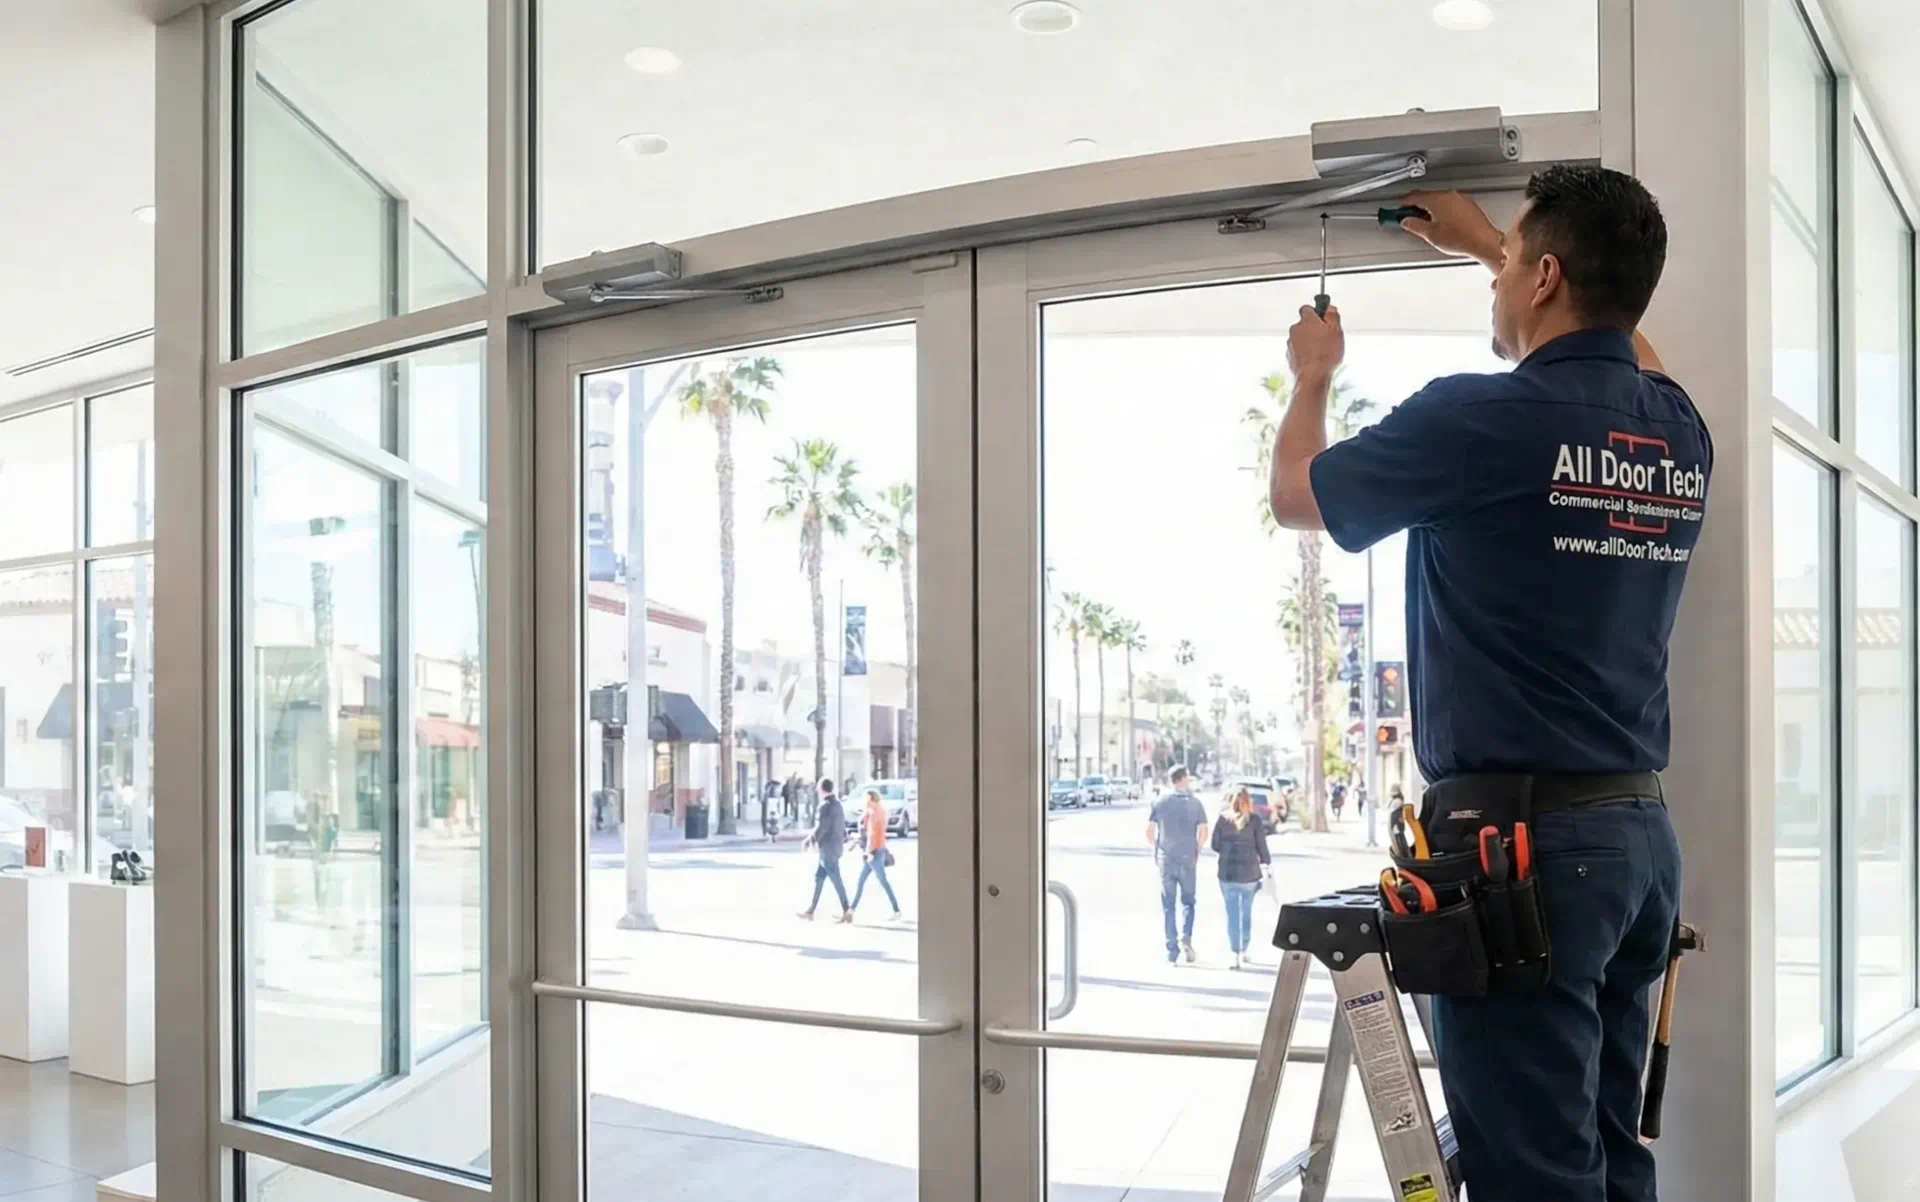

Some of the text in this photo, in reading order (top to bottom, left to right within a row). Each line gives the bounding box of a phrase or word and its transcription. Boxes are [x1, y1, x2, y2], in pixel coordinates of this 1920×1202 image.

[1552, 444, 1705, 499] All Door Tech
[1549, 491, 1624, 512] Commercial
